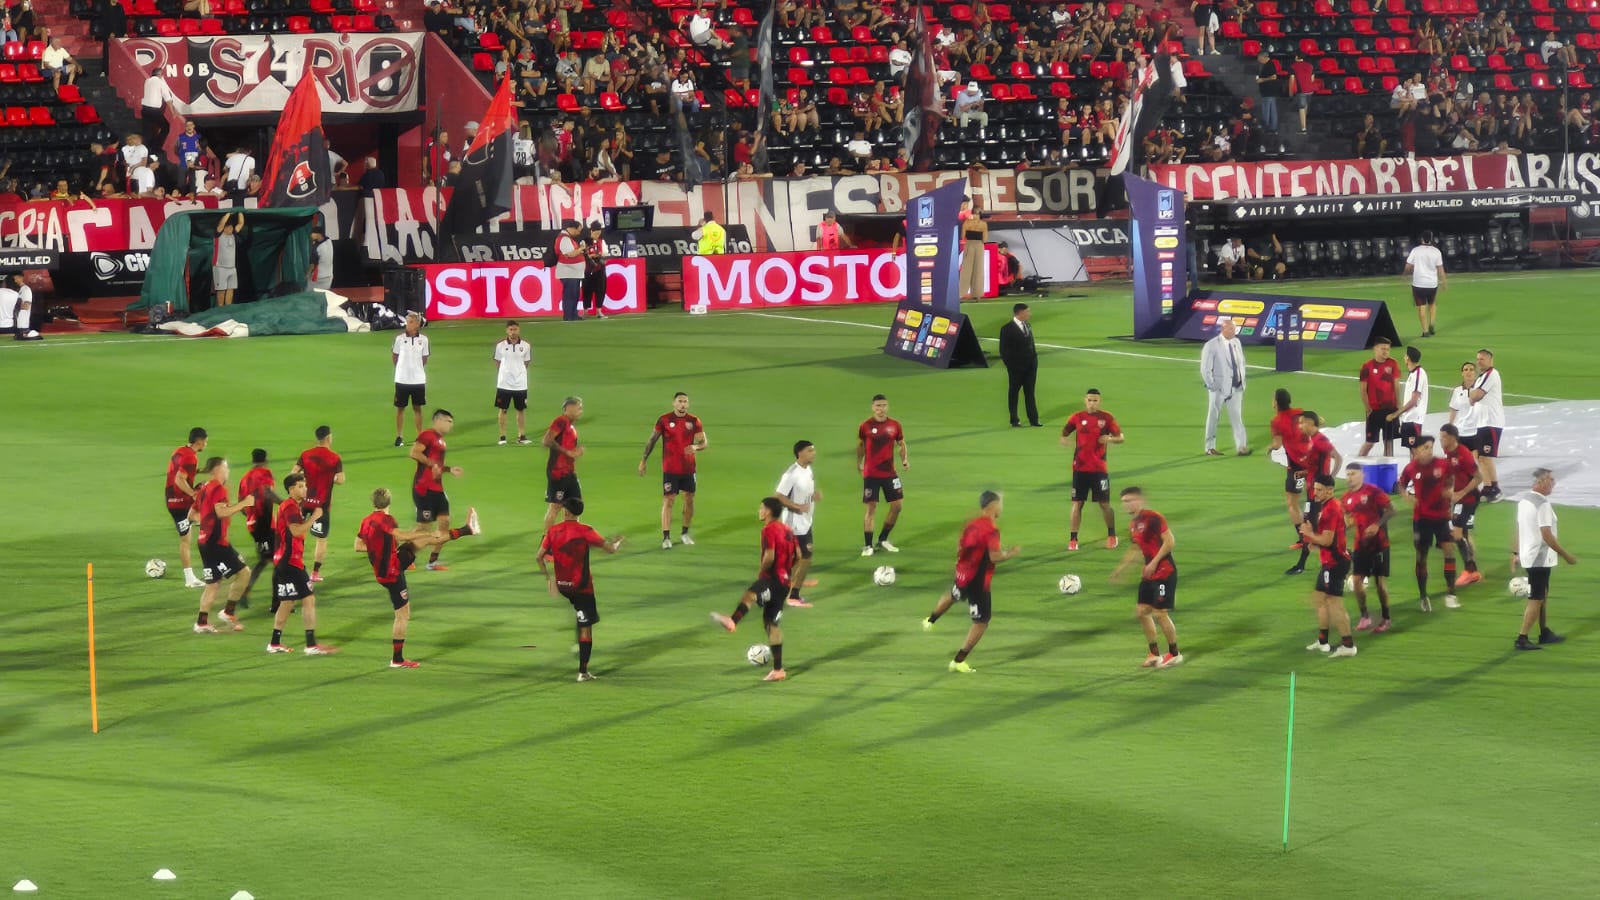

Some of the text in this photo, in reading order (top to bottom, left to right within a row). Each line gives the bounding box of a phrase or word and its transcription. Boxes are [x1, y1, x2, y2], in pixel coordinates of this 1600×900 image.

[166, 62, 211, 77] NOB
[1366, 200, 1402, 211] AIFIT
[1421, 199, 1463, 208] MULTILED
[1478, 196, 1520, 206] MULTILED
[1250, 206, 1286, 216] AIFIT
[1308, 203, 1344, 214] AIFIT
[500, 245, 548, 260] Hos
[0, 256, 51, 266] MULTILED
